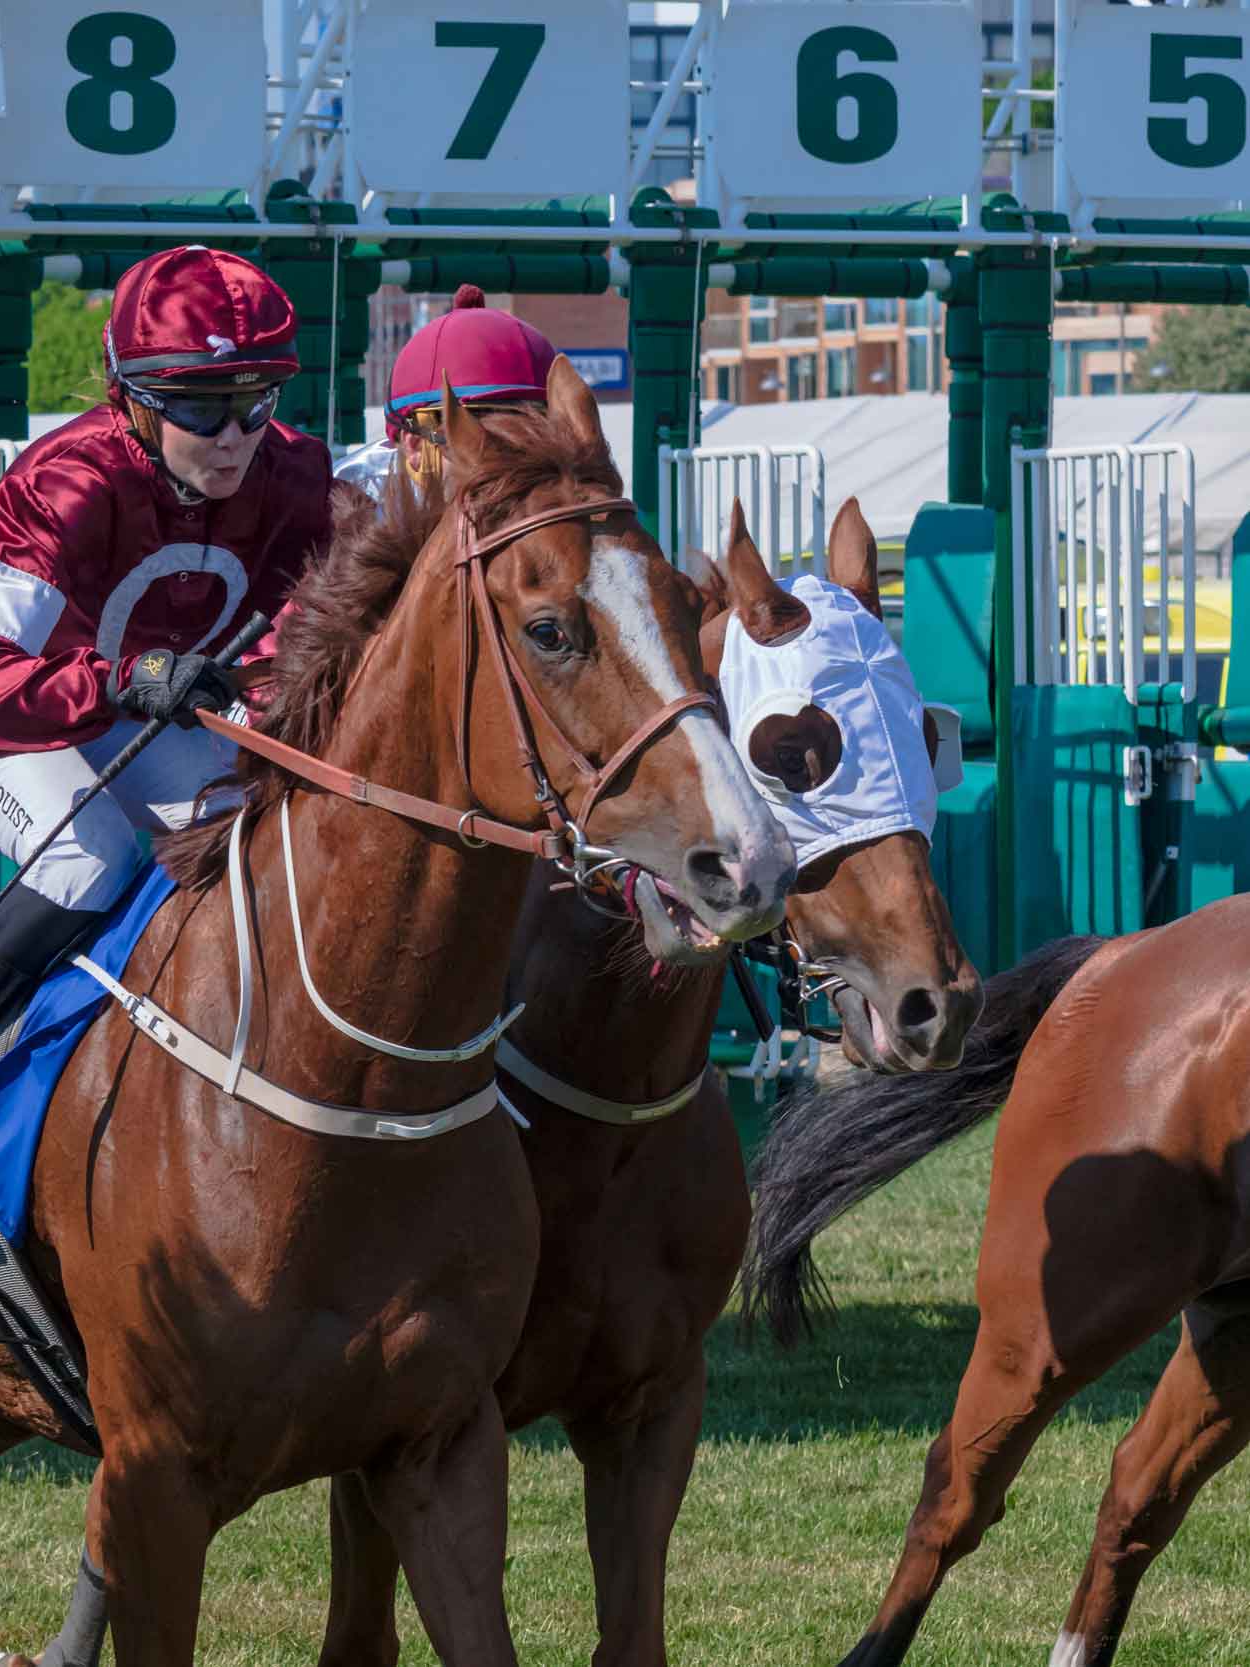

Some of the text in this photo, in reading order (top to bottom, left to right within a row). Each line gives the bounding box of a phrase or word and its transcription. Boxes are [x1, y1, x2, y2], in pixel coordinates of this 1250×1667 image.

[65, 11, 177, 156] 8
[434, 21, 546, 161] 7
[796, 25, 899, 165] 6
[1146, 32, 1247, 169] 5
